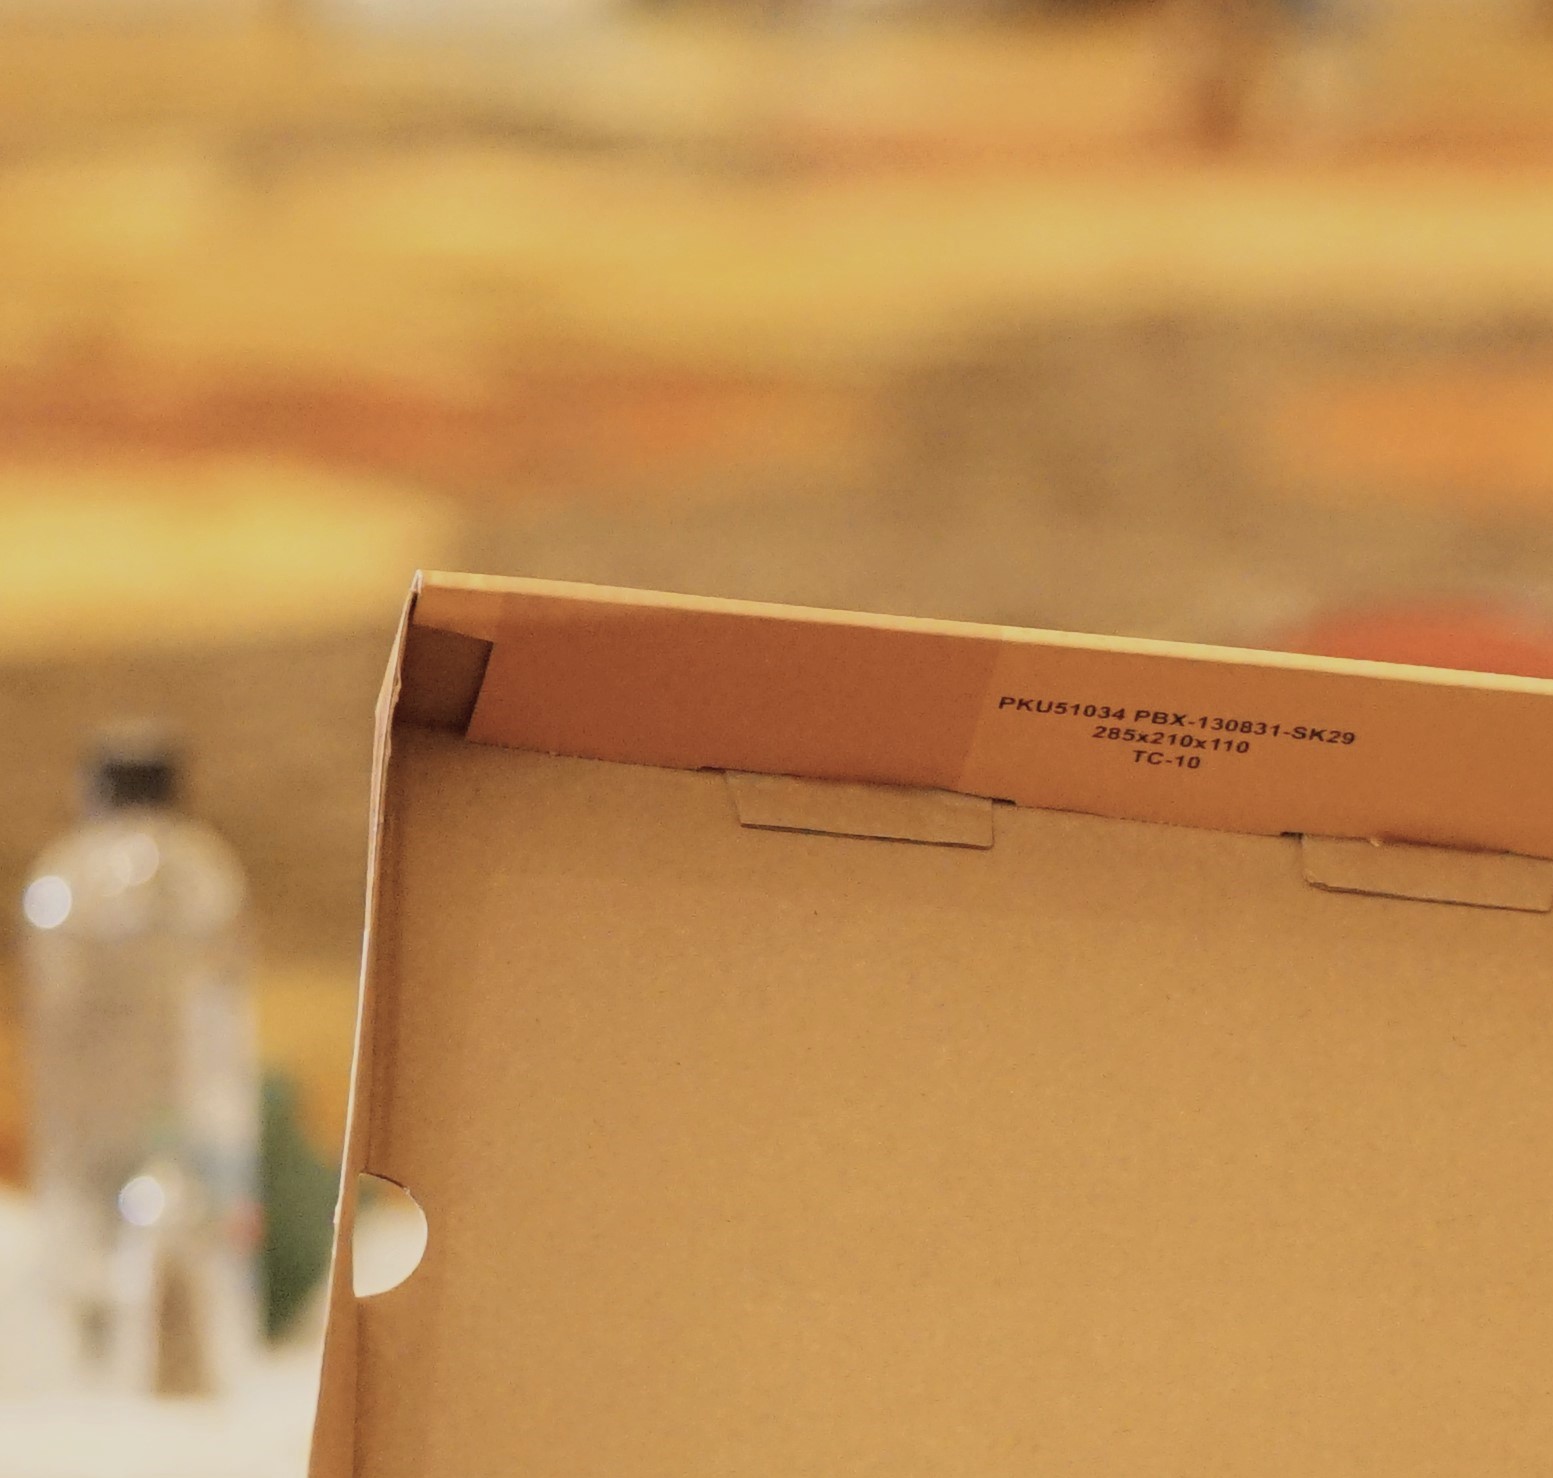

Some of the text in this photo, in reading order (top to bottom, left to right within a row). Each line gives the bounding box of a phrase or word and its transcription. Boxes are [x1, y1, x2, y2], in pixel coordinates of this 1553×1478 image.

[999, 695, 1357, 746] PKU51034 PBX-130831-SK29
[1092, 724, 1251, 755] 285x210x110
[1132, 749, 1201, 770] TC-10
